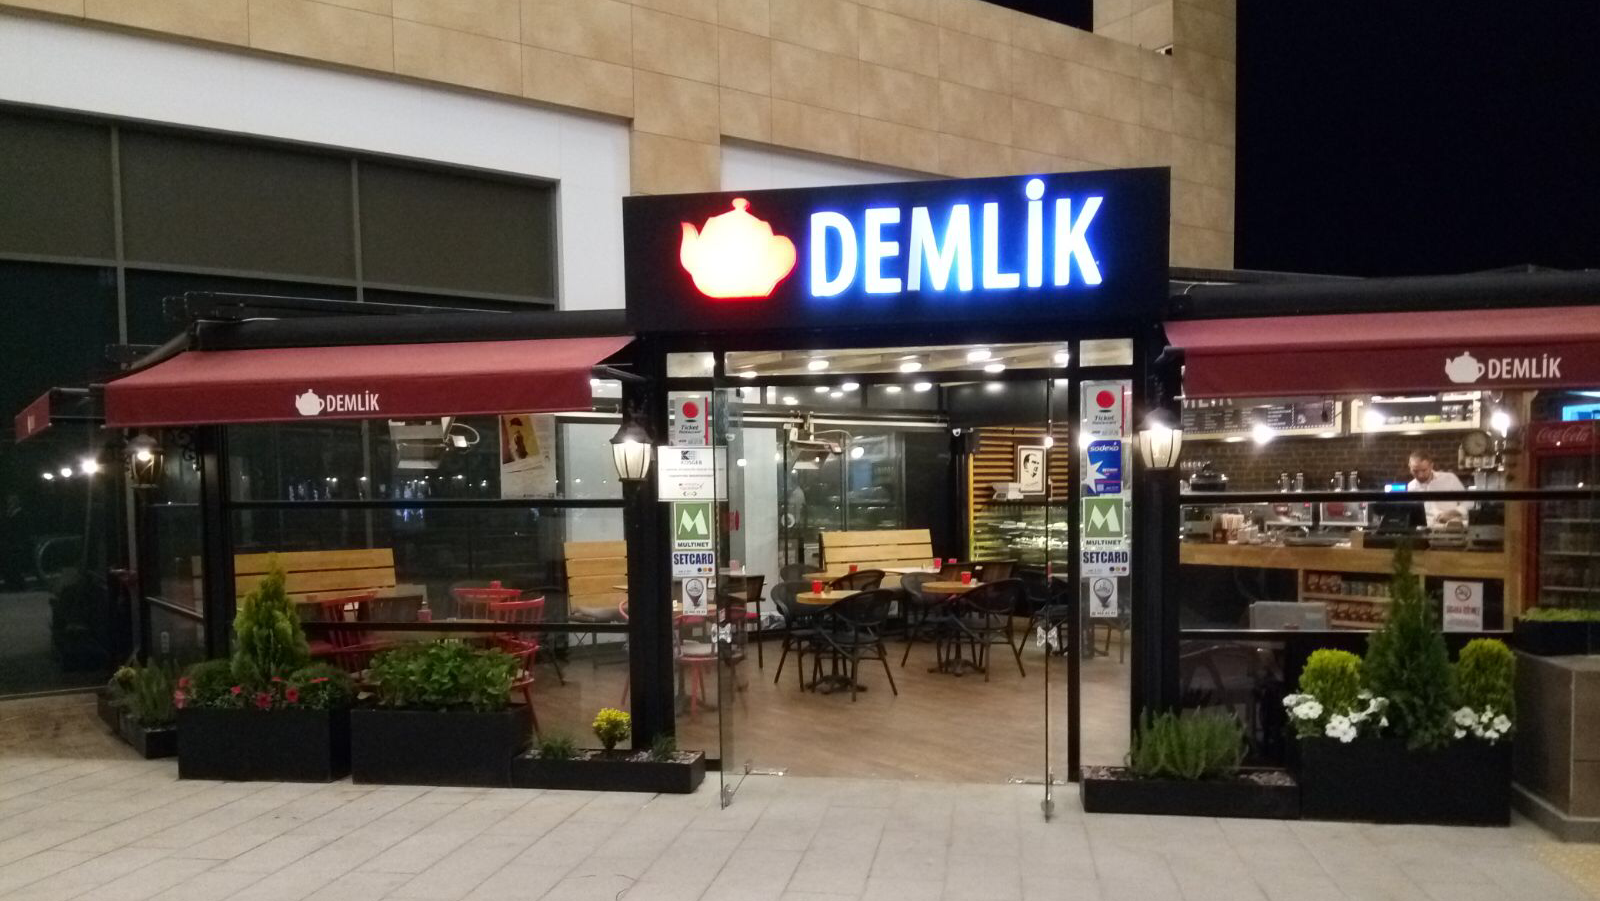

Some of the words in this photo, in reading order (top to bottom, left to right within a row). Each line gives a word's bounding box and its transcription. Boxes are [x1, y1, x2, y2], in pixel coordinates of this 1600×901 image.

[811, 178, 1104, 297] DEMLİK
[1487, 353, 1562, 379] DEMLİK
[326, 390, 380, 411] DEMLİK
[1090, 443, 1120, 452] sodexo
[673, 553, 714, 565] SETCARD
[1082, 551, 1129, 564] SETCARD
